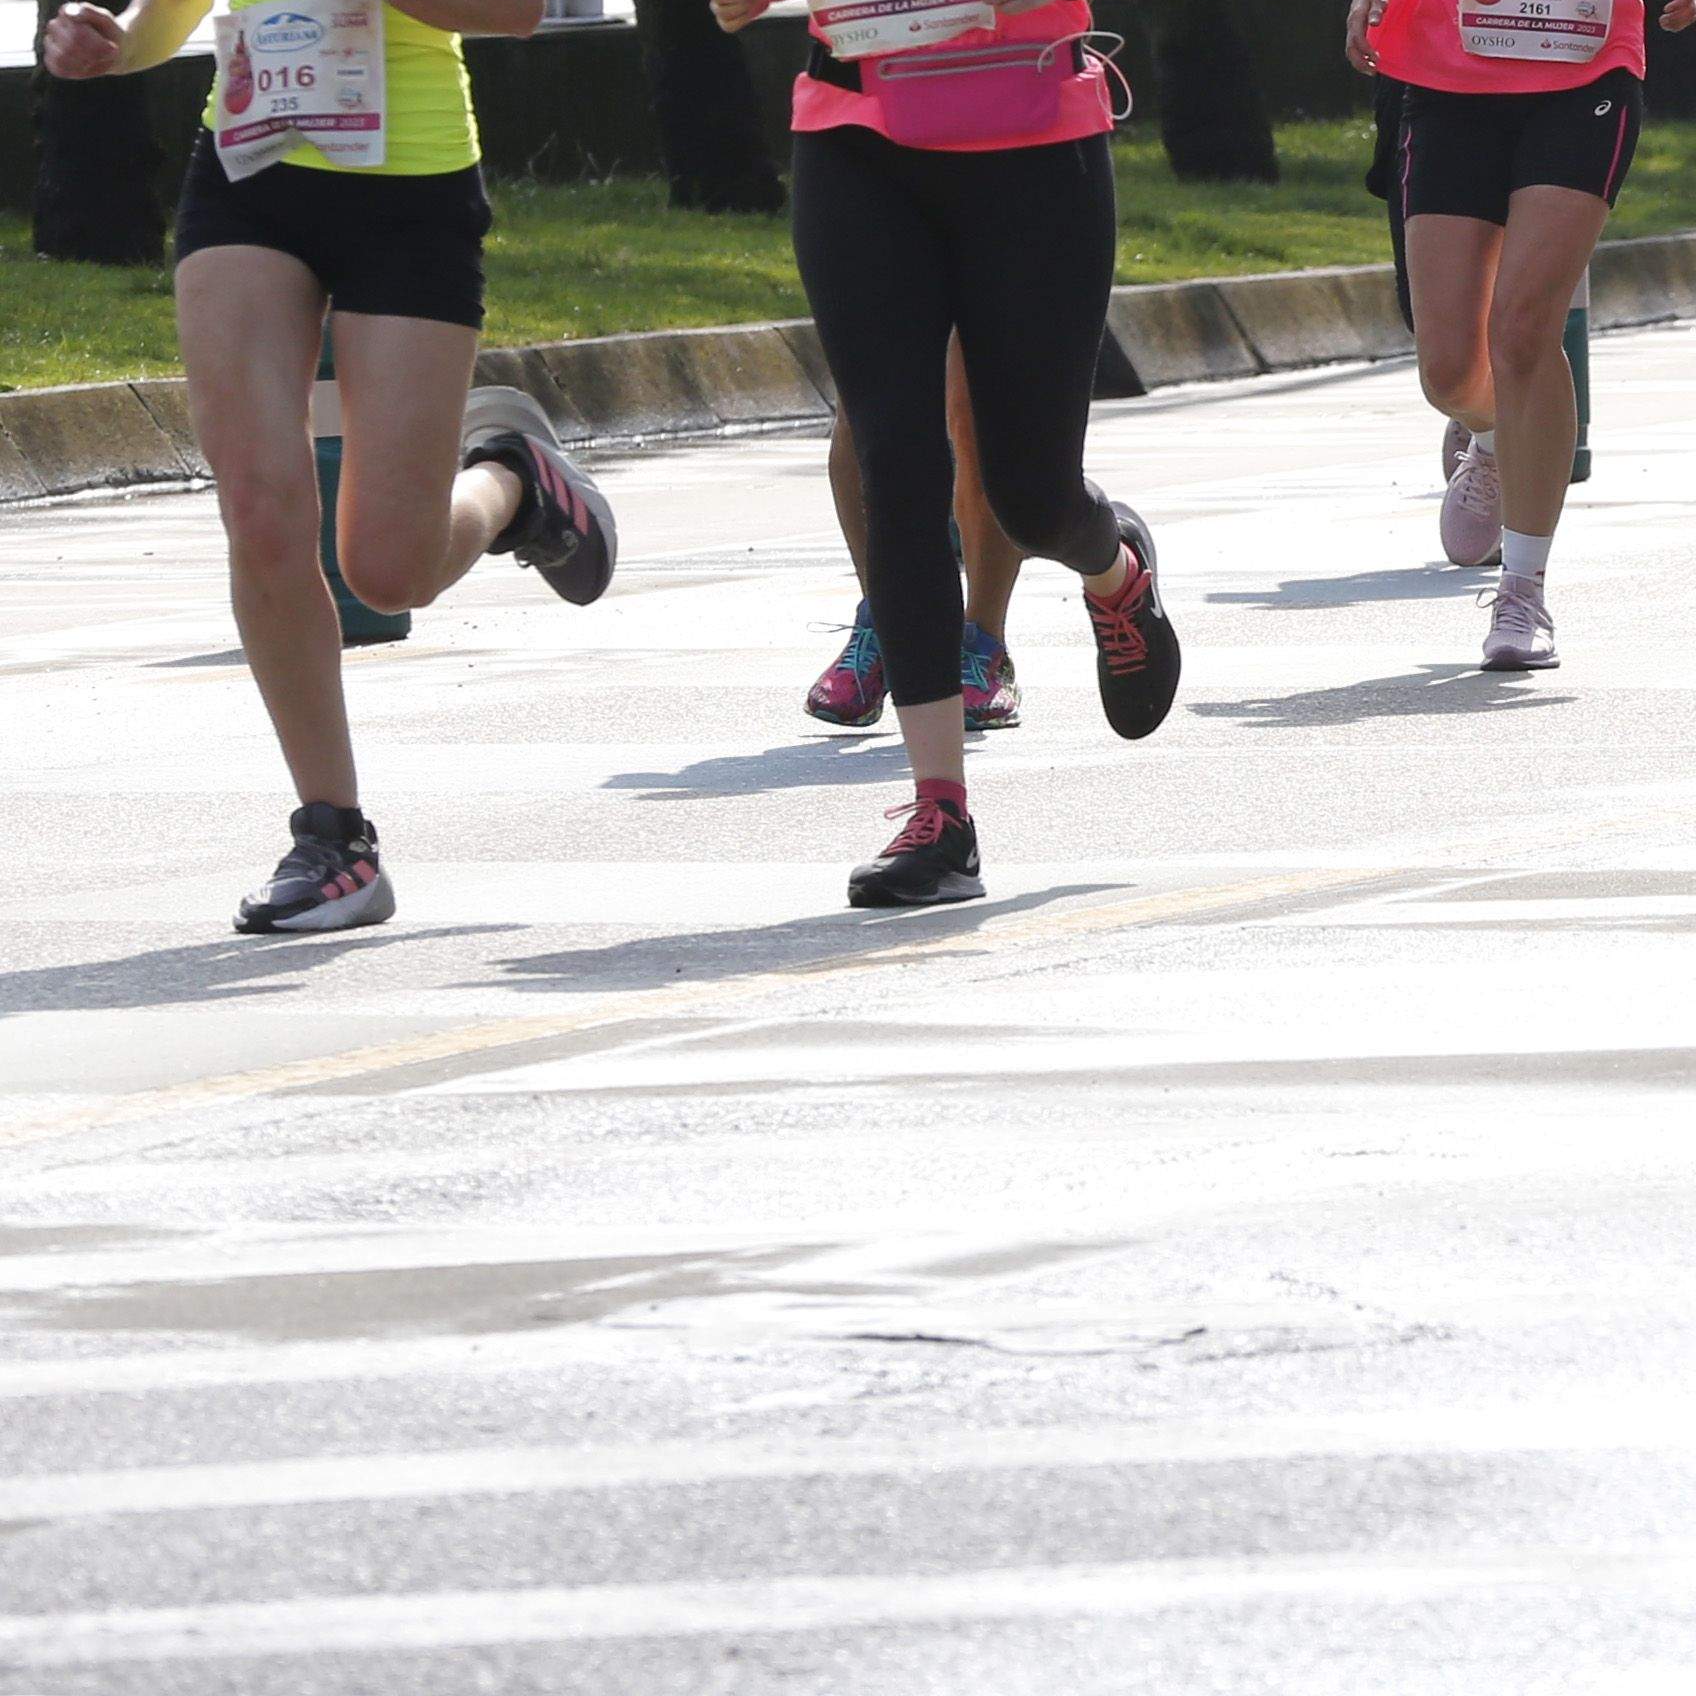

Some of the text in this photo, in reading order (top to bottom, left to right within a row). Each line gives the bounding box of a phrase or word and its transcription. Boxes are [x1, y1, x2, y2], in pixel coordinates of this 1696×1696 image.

[827, 5, 877, 22] CARRERA
[878, 2, 895, 14] DE
[895, 0, 910, 12] LA
[1519, 2, 1551, 16] 2161
[1475, 17, 1517, 28] CARRERA
[1517, 19, 1530, 28] DE
[1531, 20, 1544, 29] LA
[1545, 21, 1575, 32] MUJER
[1471, 34, 1516, 48] OYSHO
[1553, 41, 1597, 54] Santander
[258, 65, 316, 92] 016
[270, 97, 299, 113] 235
